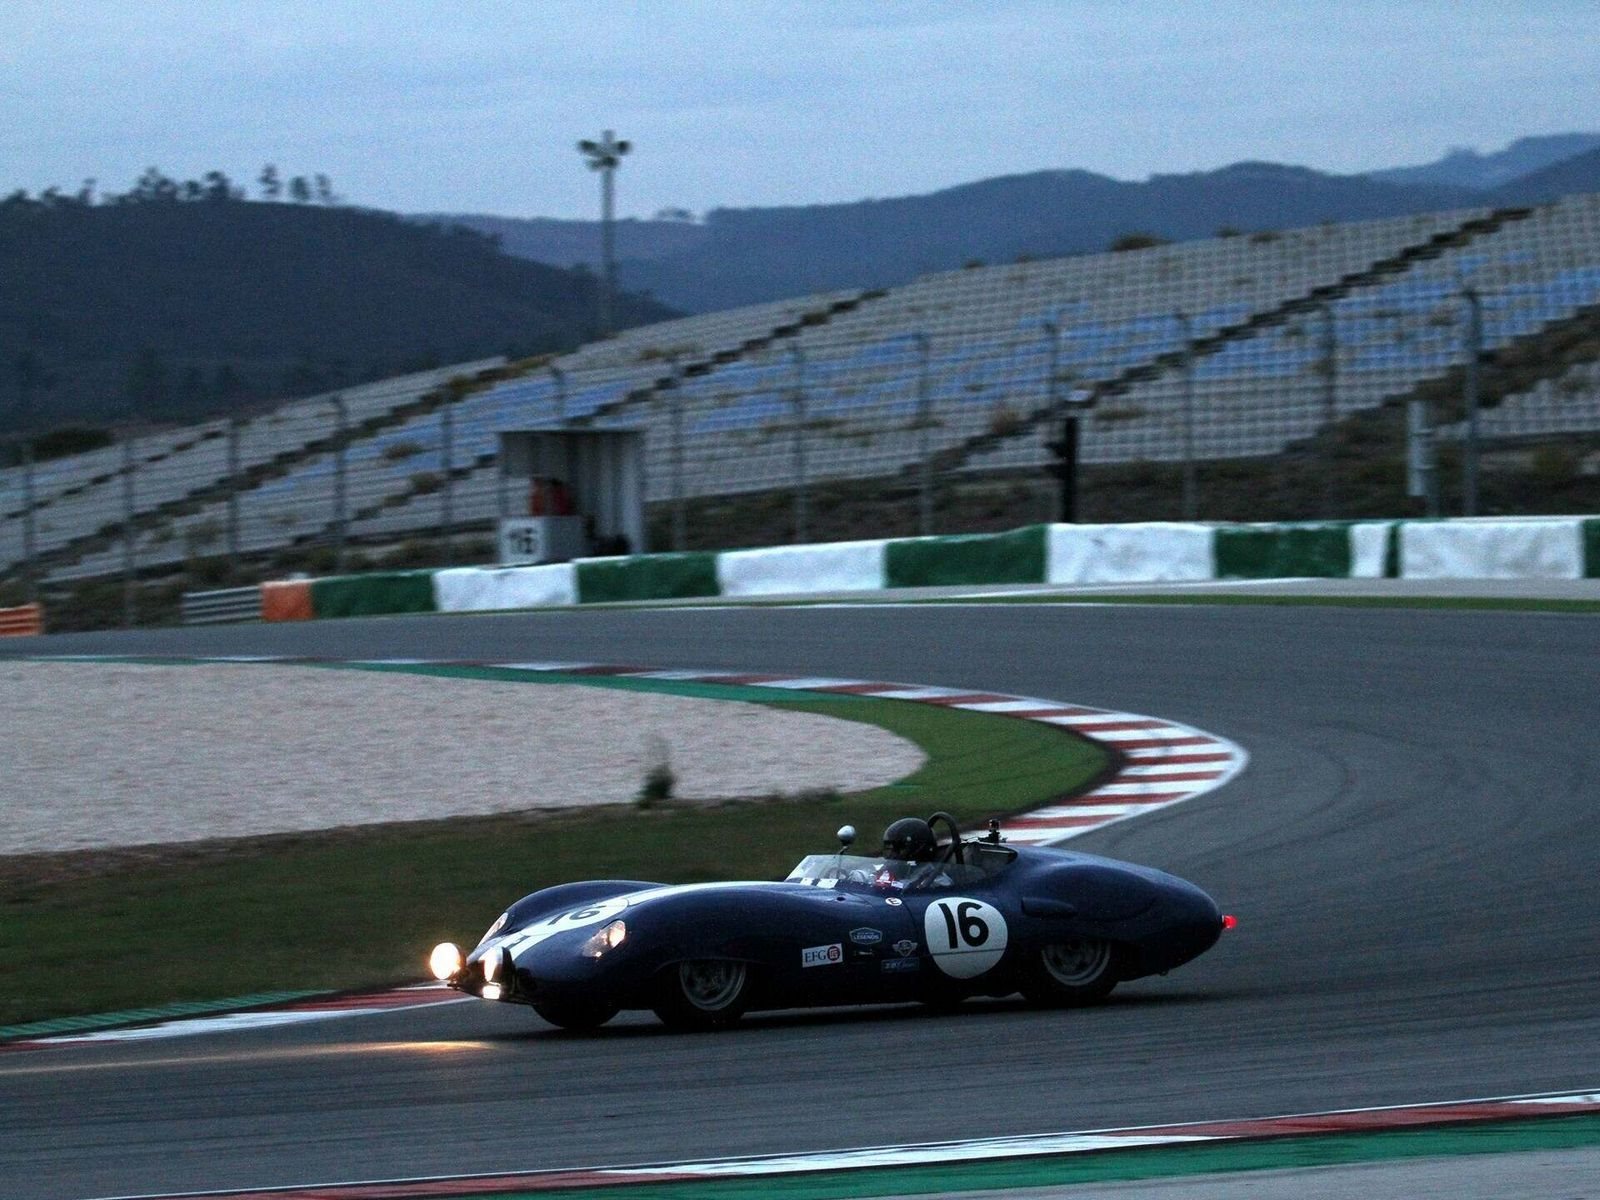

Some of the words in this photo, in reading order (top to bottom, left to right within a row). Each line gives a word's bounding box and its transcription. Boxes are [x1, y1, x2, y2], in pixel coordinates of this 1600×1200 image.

[547, 905, 607, 926] 16
[937, 901, 989, 949] 16
[804, 950, 827, 963] EFG
